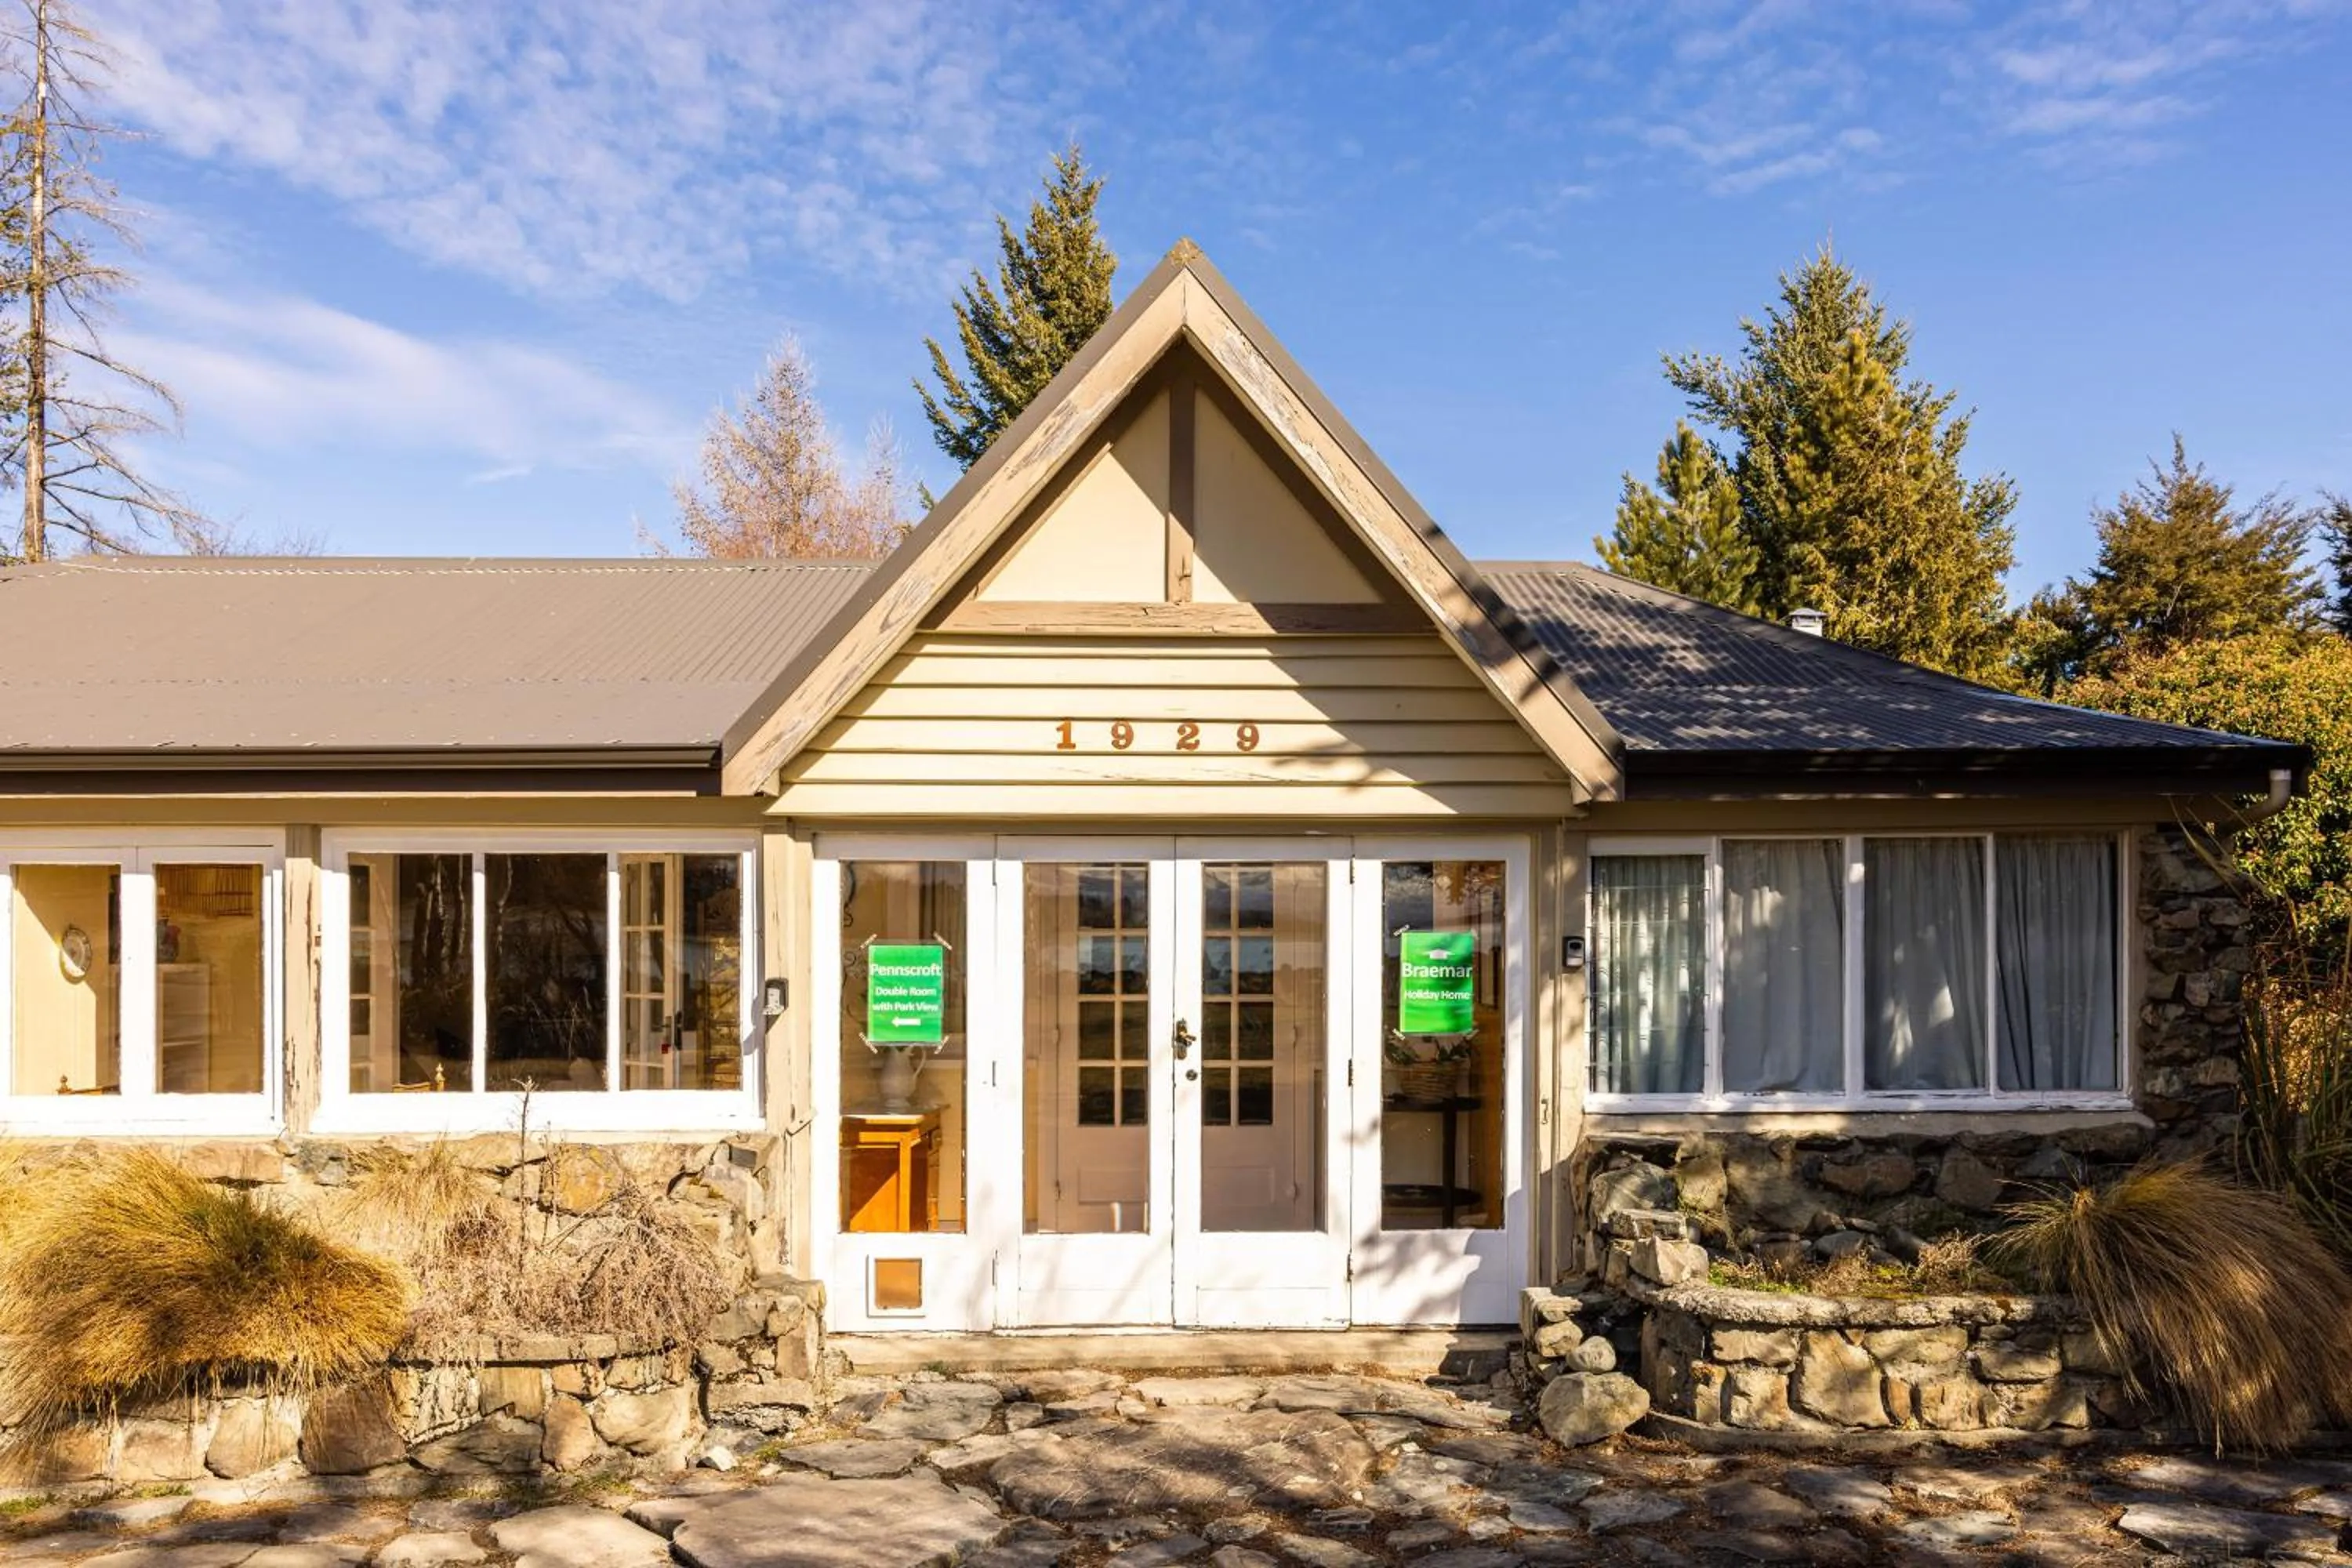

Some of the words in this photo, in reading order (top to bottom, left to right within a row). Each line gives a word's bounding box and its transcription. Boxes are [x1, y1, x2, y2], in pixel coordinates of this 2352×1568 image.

[869, 964, 942, 976] Pennscroft
[1402, 963, 1472, 978] Braemar
[876, 986, 907, 996] Double
[909, 987, 936, 996] Room
[1405, 990, 1439, 1000] Holiday
[1441, 990, 1471, 1000] Home
[872, 1001, 892, 1011] with
[895, 1002, 914, 1011] Park
[916, 1002, 938, 1011] View
